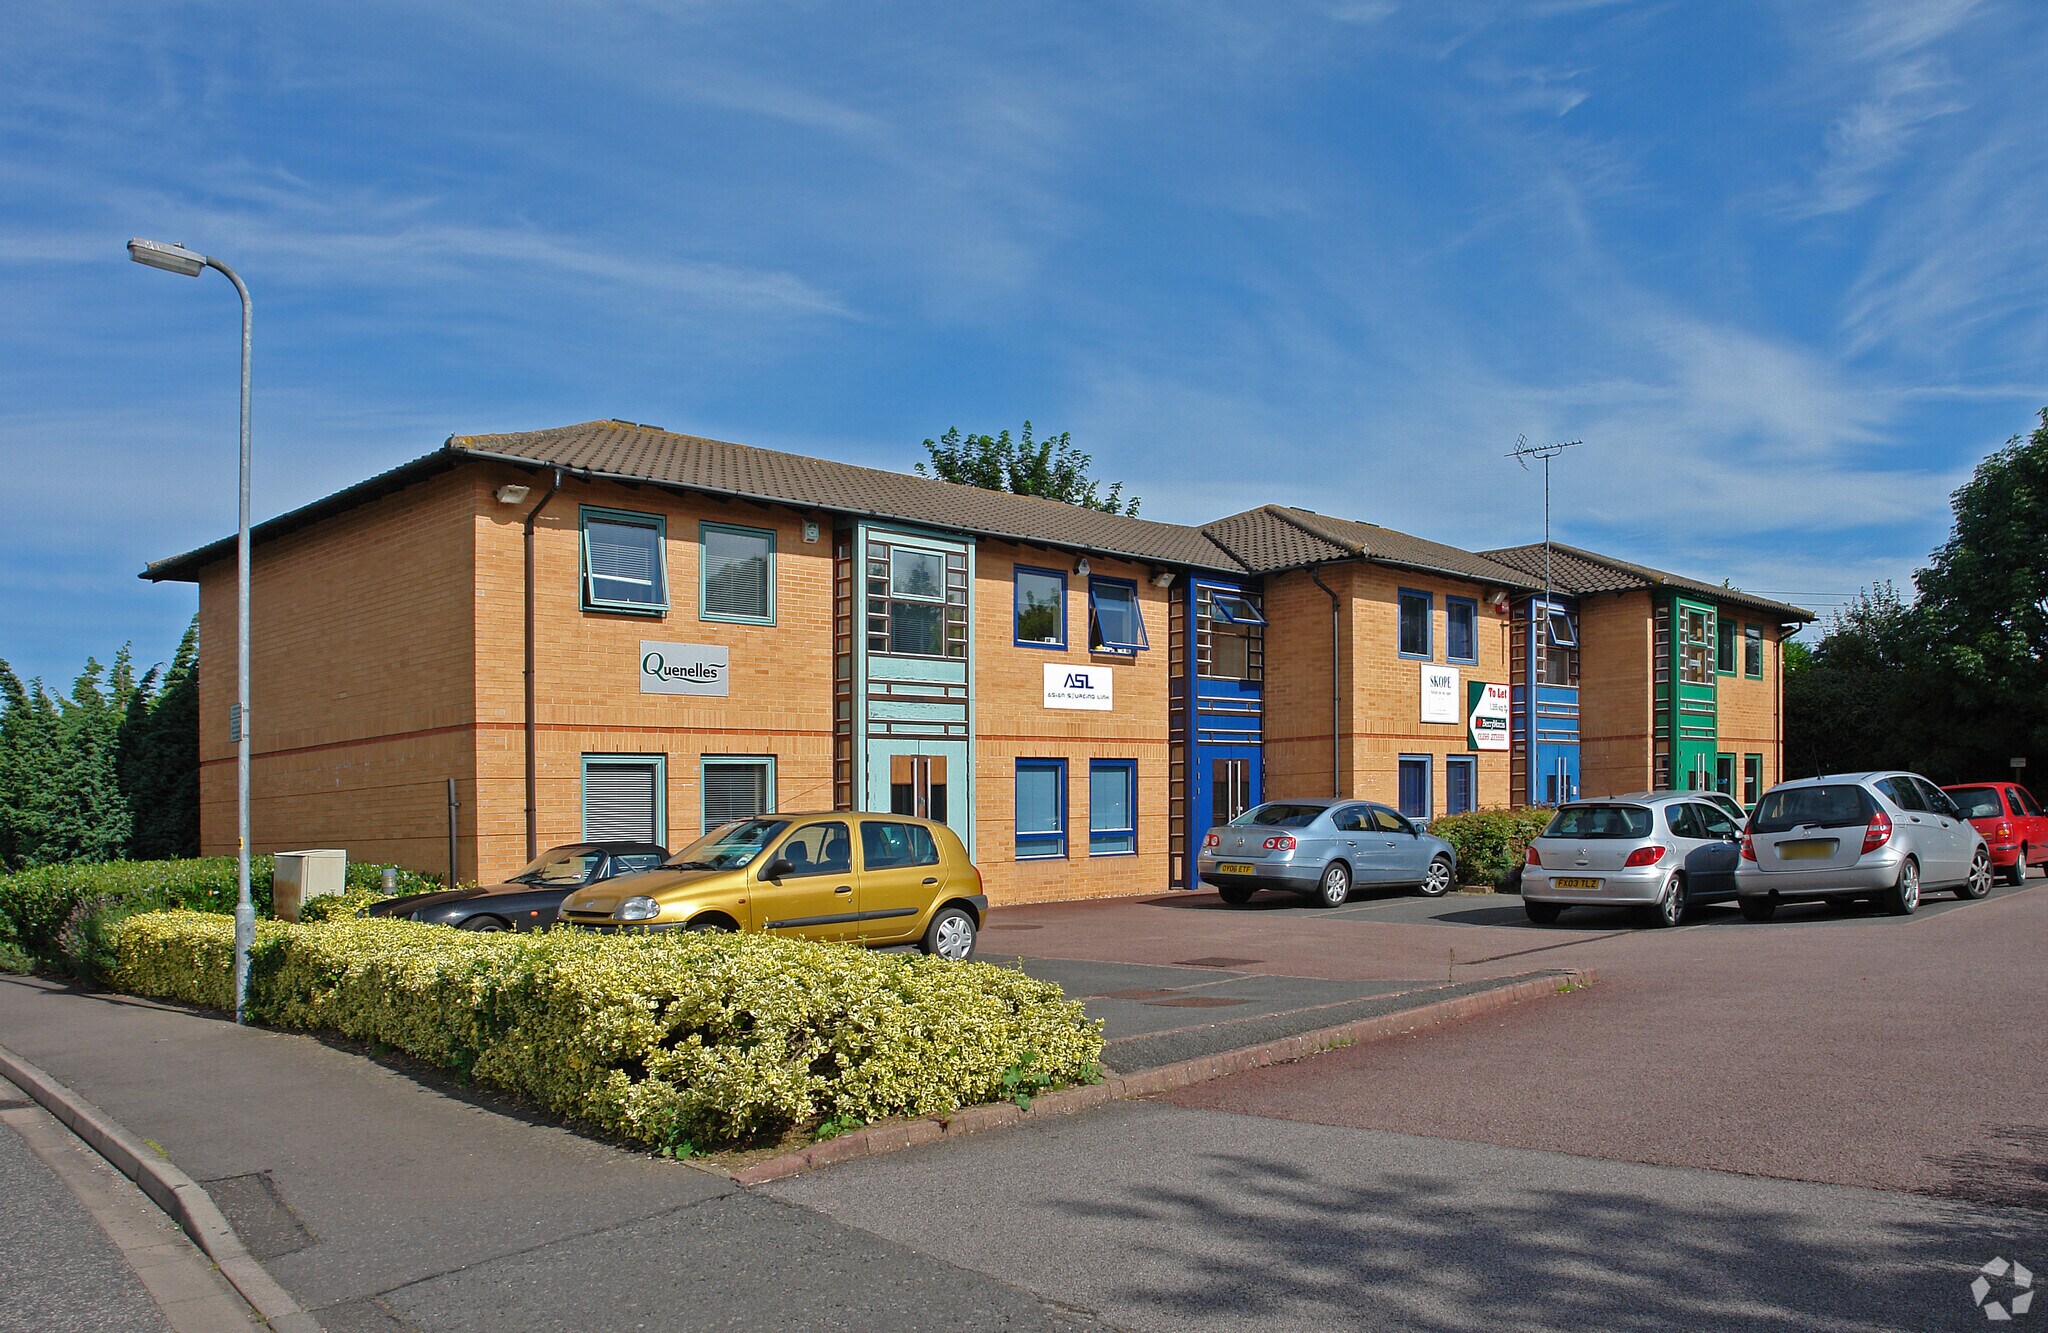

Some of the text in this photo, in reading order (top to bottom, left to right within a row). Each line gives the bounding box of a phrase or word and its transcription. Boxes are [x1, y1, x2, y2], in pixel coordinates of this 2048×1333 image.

[642, 652, 719, 682] Quenelles
[1064, 673, 1094, 689] ASL
[1430, 675, 1452, 688] SKOPE
[1488, 687, 1507, 698] To Let
[1558, 879, 1596, 888] FX03 TLZ
